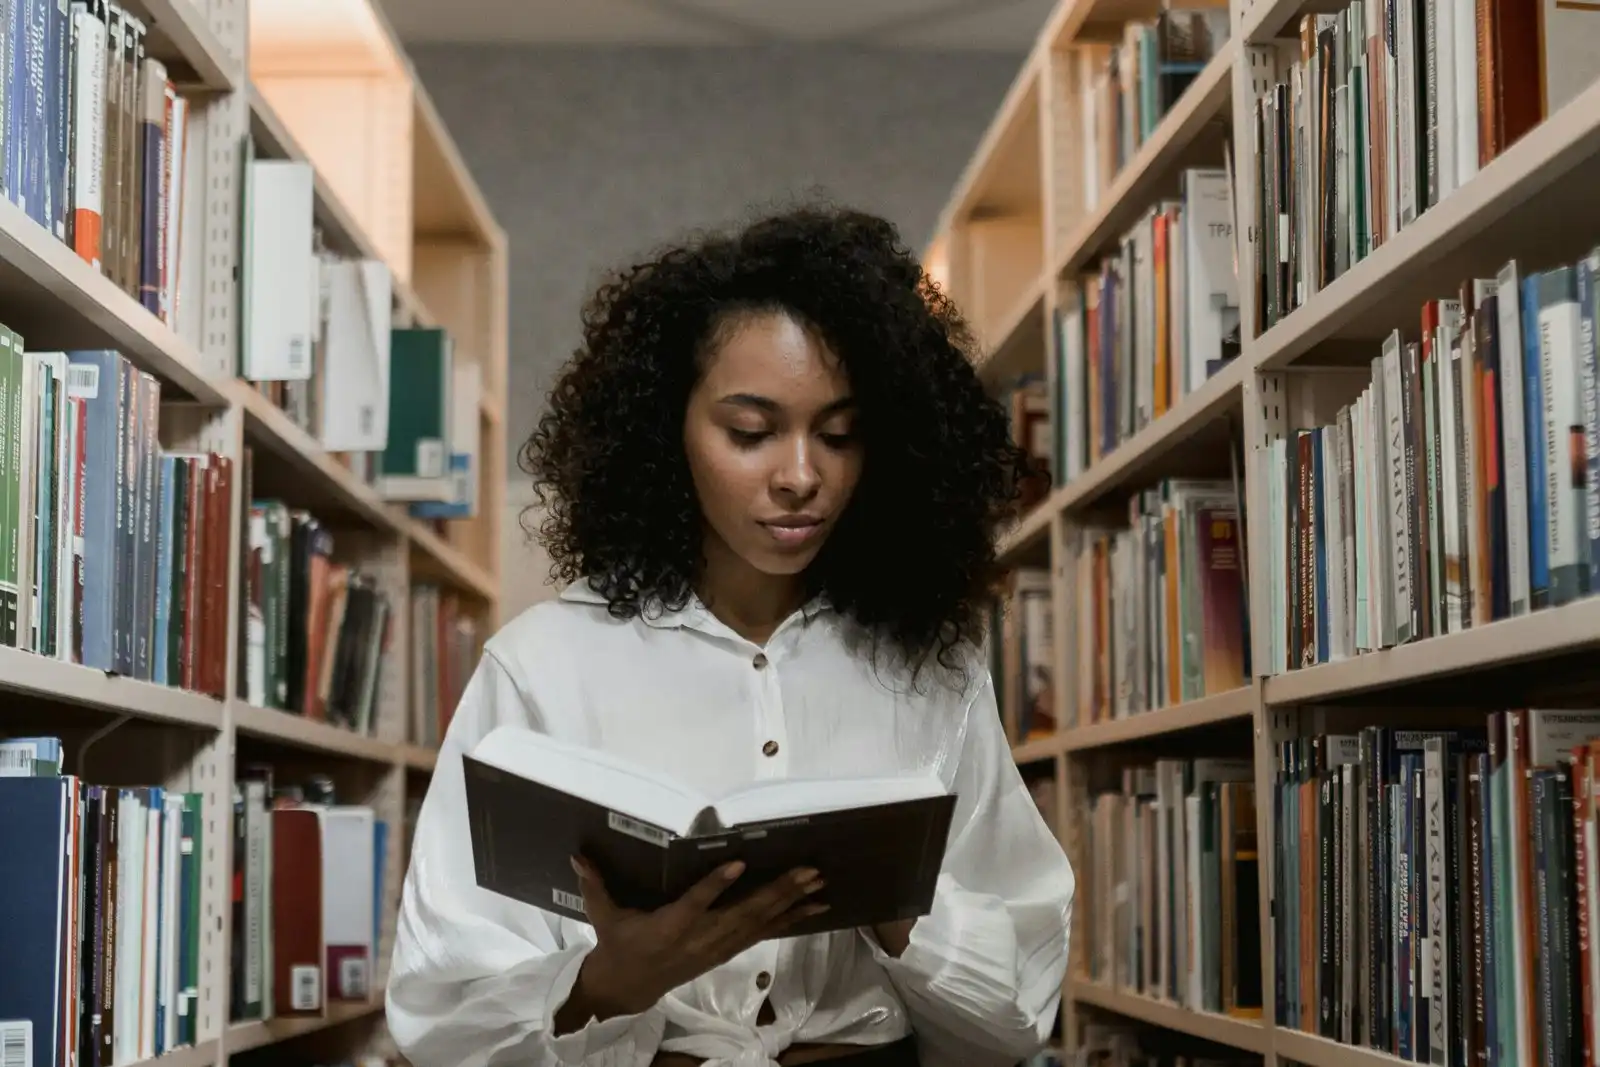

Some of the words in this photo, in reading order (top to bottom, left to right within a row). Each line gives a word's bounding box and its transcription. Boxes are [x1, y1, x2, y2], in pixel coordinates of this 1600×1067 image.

[30, 24, 38, 88] ПРАВО
[36, 3, 45, 118] УГОЛОВНОЕ
[1543, 321, 1554, 412] НАСТОЛЬНАЯ
[1582, 319, 1597, 460] ПРОКУРОРСКИЙ
[1547, 419, 1556, 465] КНИГА
[1391, 415, 1406, 594] НОТАРИАТ
[1549, 471, 1560, 555] ПРОКУРОРА
[1401, 853, 1409, 937] ПРОКУРАТУРА
[1428, 798, 1444, 1042] АДВОКАТУРА
[1471, 817, 1481, 929] АДВОКАТУРА
[1476, 947, 1484, 1023] РОССИИ
[1572, 799, 1587, 951] АДВОКАТУРА
